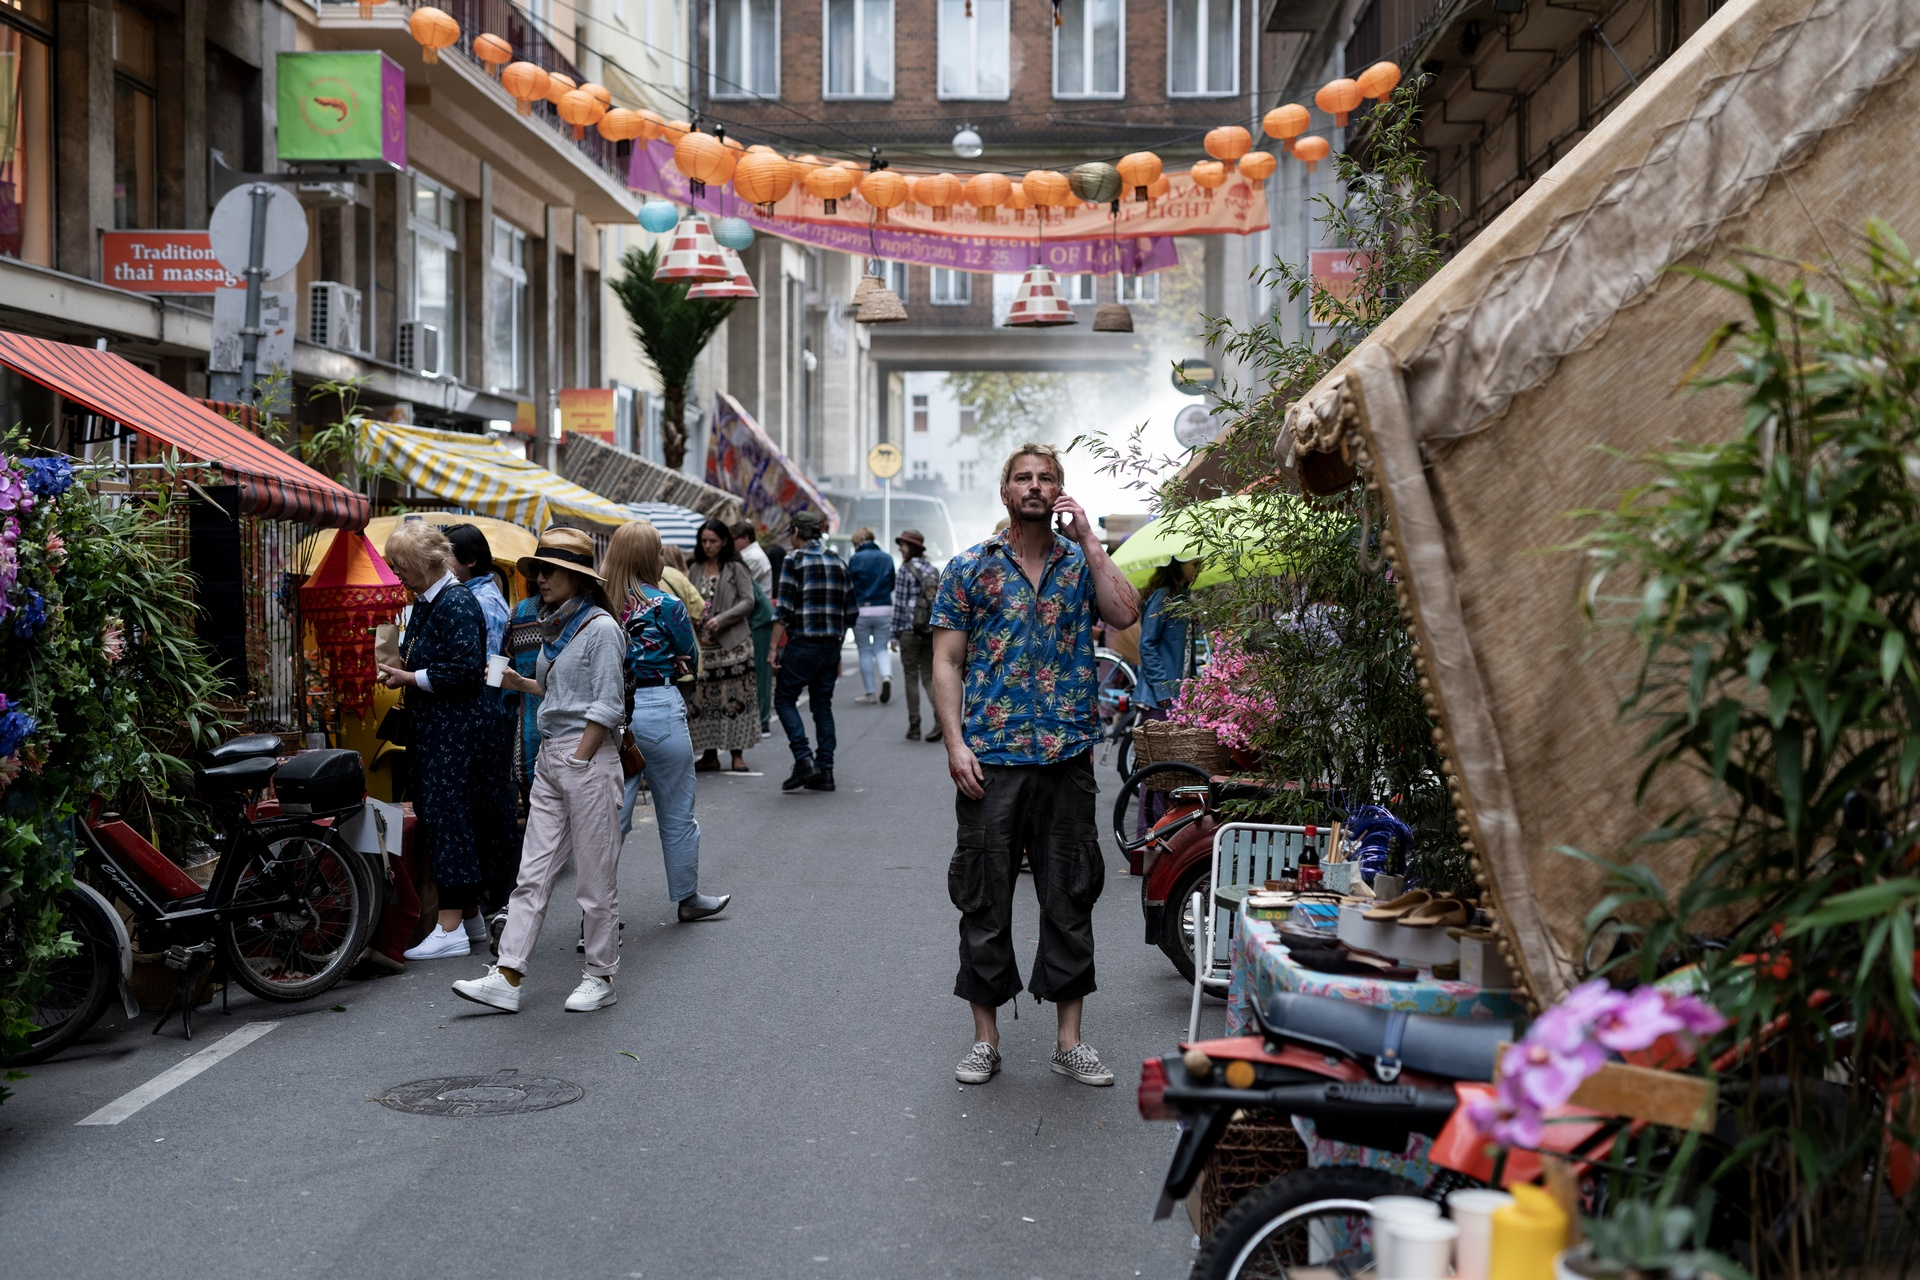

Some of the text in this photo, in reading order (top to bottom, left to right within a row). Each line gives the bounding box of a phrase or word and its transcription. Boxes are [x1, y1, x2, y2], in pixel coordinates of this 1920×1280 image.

[1145, 201, 1215, 219] LIGHT
[1050, 246, 1081, 265] OF
[114, 262, 247, 288] thai massag
